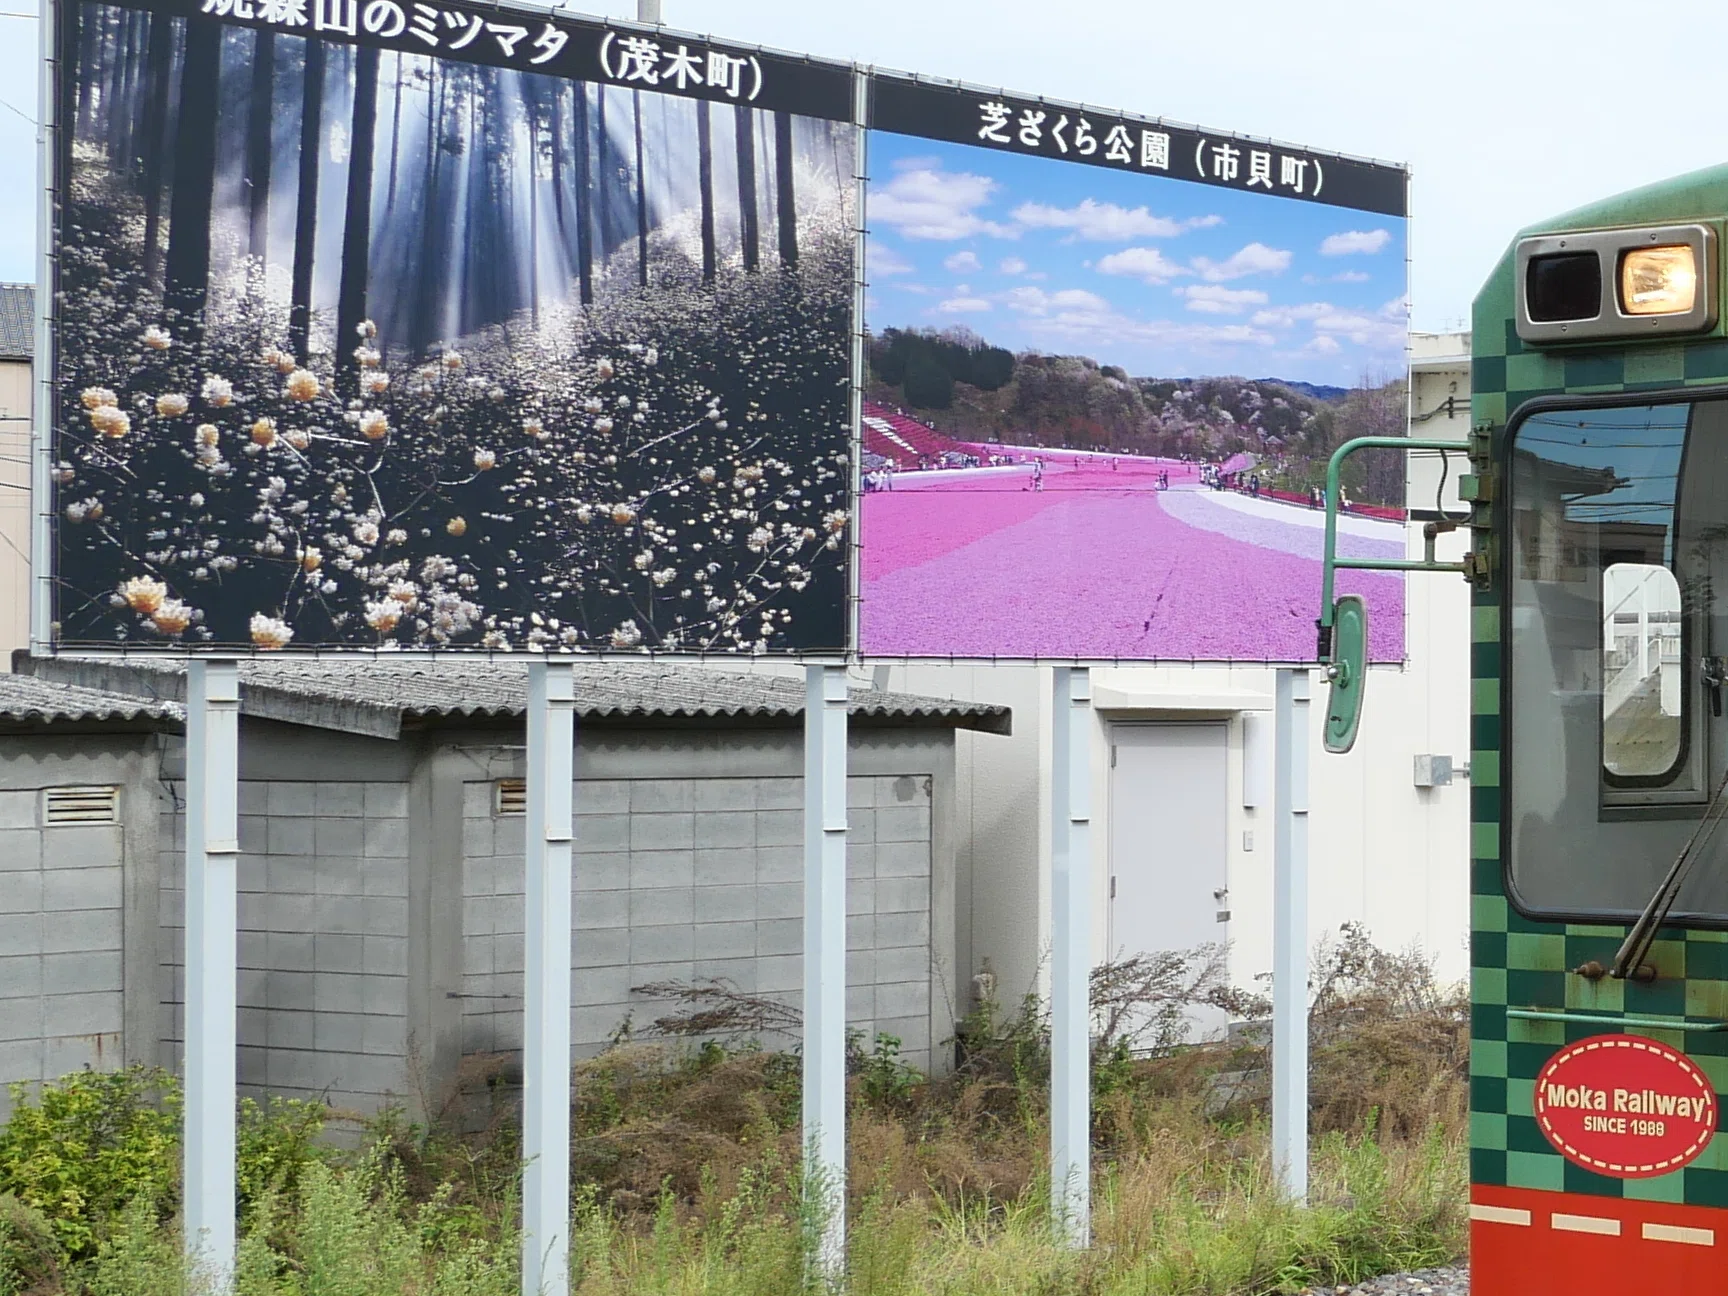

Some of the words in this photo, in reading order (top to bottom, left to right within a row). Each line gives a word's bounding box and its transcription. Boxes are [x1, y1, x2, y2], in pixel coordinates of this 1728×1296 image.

[1547, 1084, 1607, 1111] Moka
[1613, 1088, 1706, 1123] Railway
[1584, 1115, 1627, 1134] SINCE
[1630, 1119, 1665, 1137] 1988
